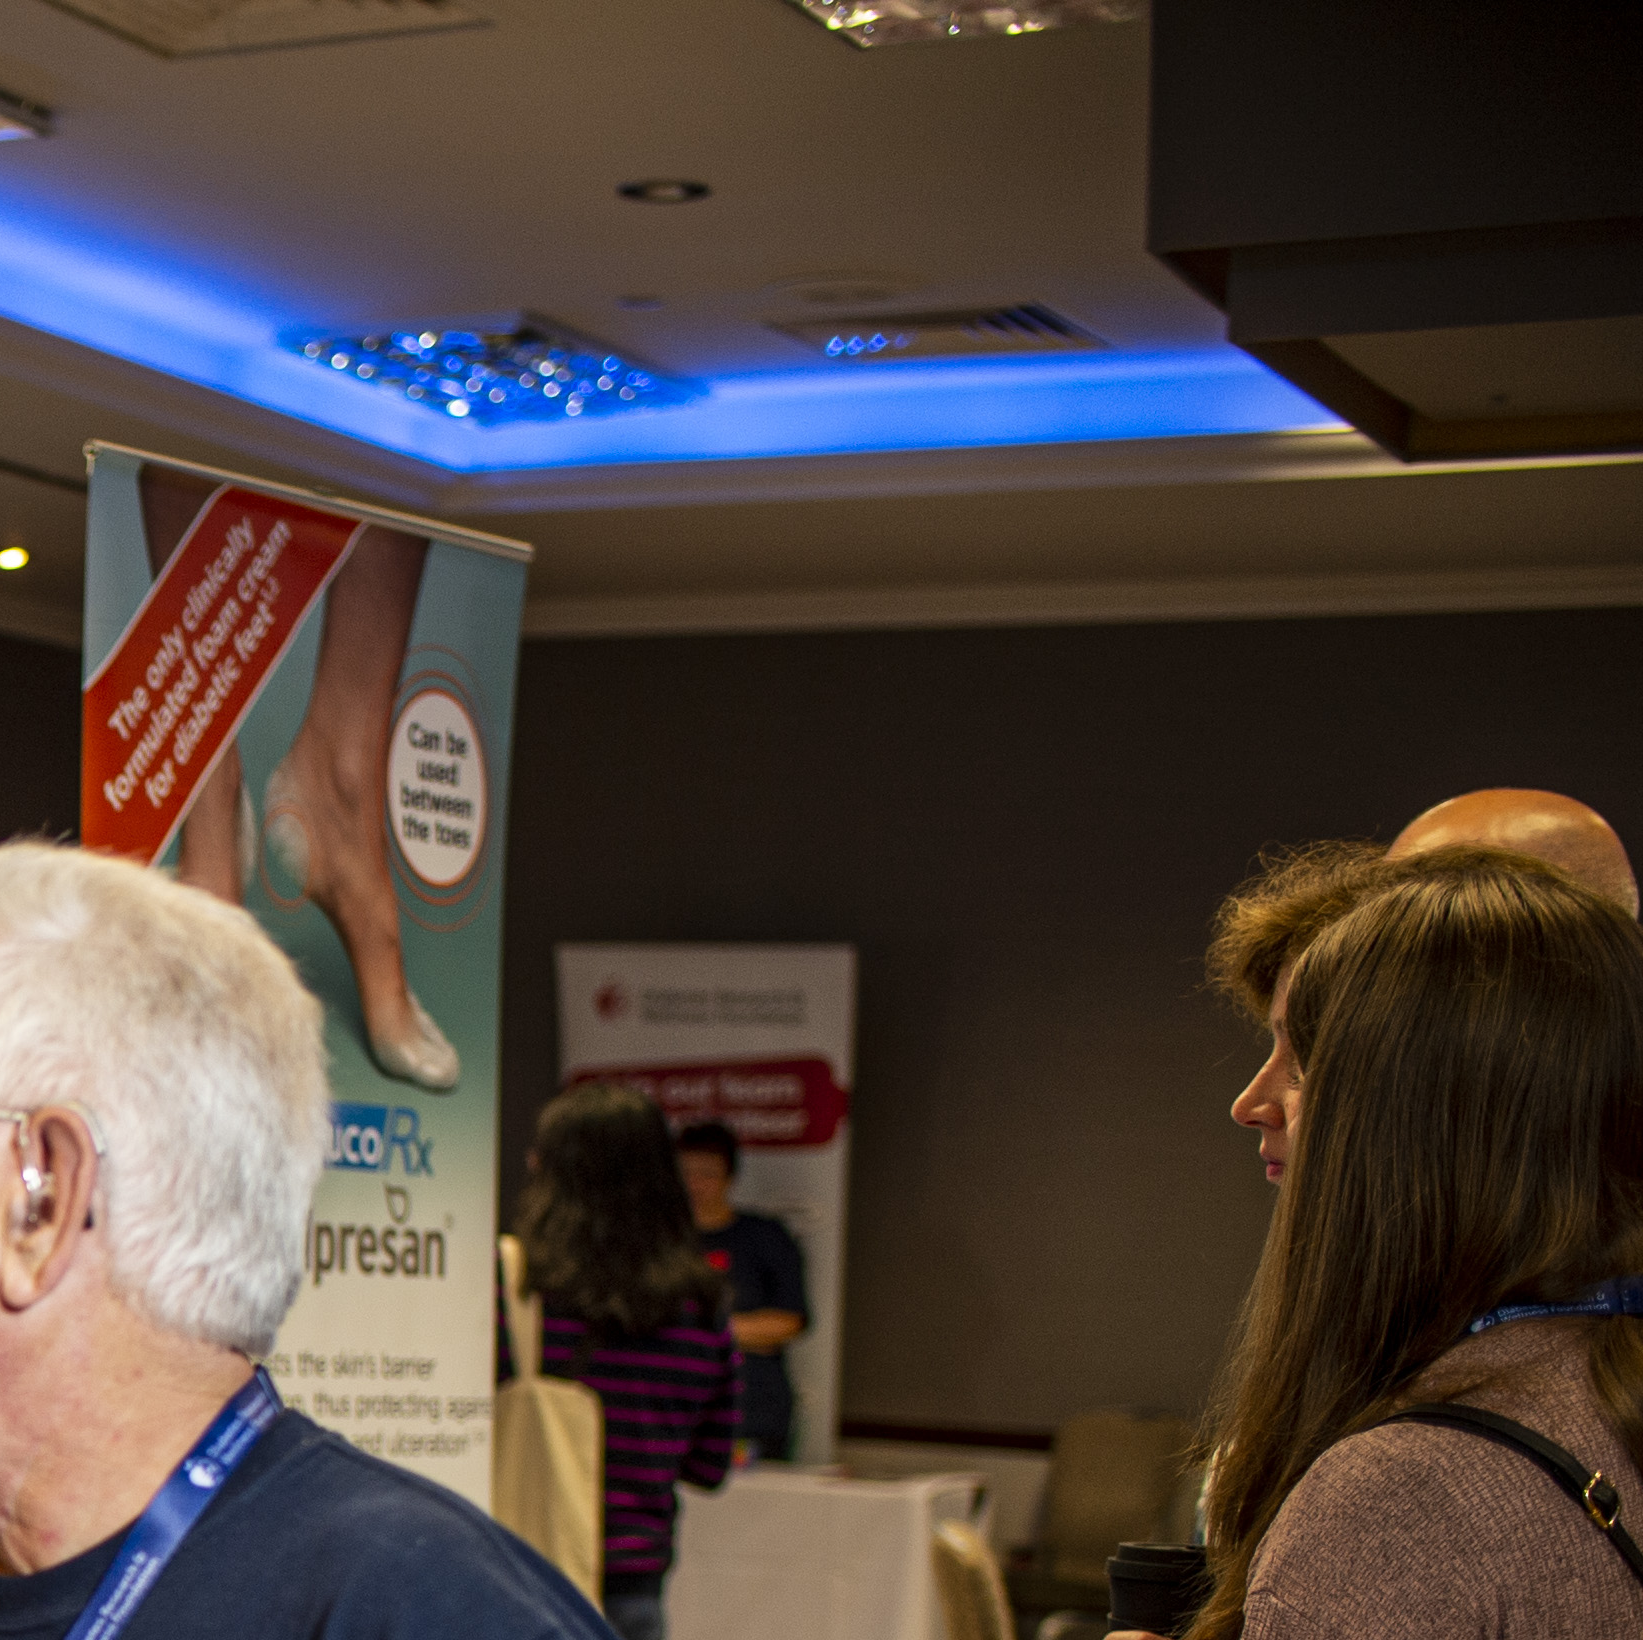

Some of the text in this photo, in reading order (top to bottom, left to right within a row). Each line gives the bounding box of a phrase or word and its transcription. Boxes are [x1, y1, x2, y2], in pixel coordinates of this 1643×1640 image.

[107, 516, 255, 740] The only clinically
[103, 520, 293, 812] formulated foam cream
[144, 759, 176, 809] for
[174, 655, 241, 765] diabetic
[234, 600, 276, 663] feet
[408, 721, 467, 758] Can be
[400, 781, 473, 818] between
[417, 760, 459, 786] used
[403, 815, 470, 849] the toes
[327, 1106, 434, 1176] ucoRx
